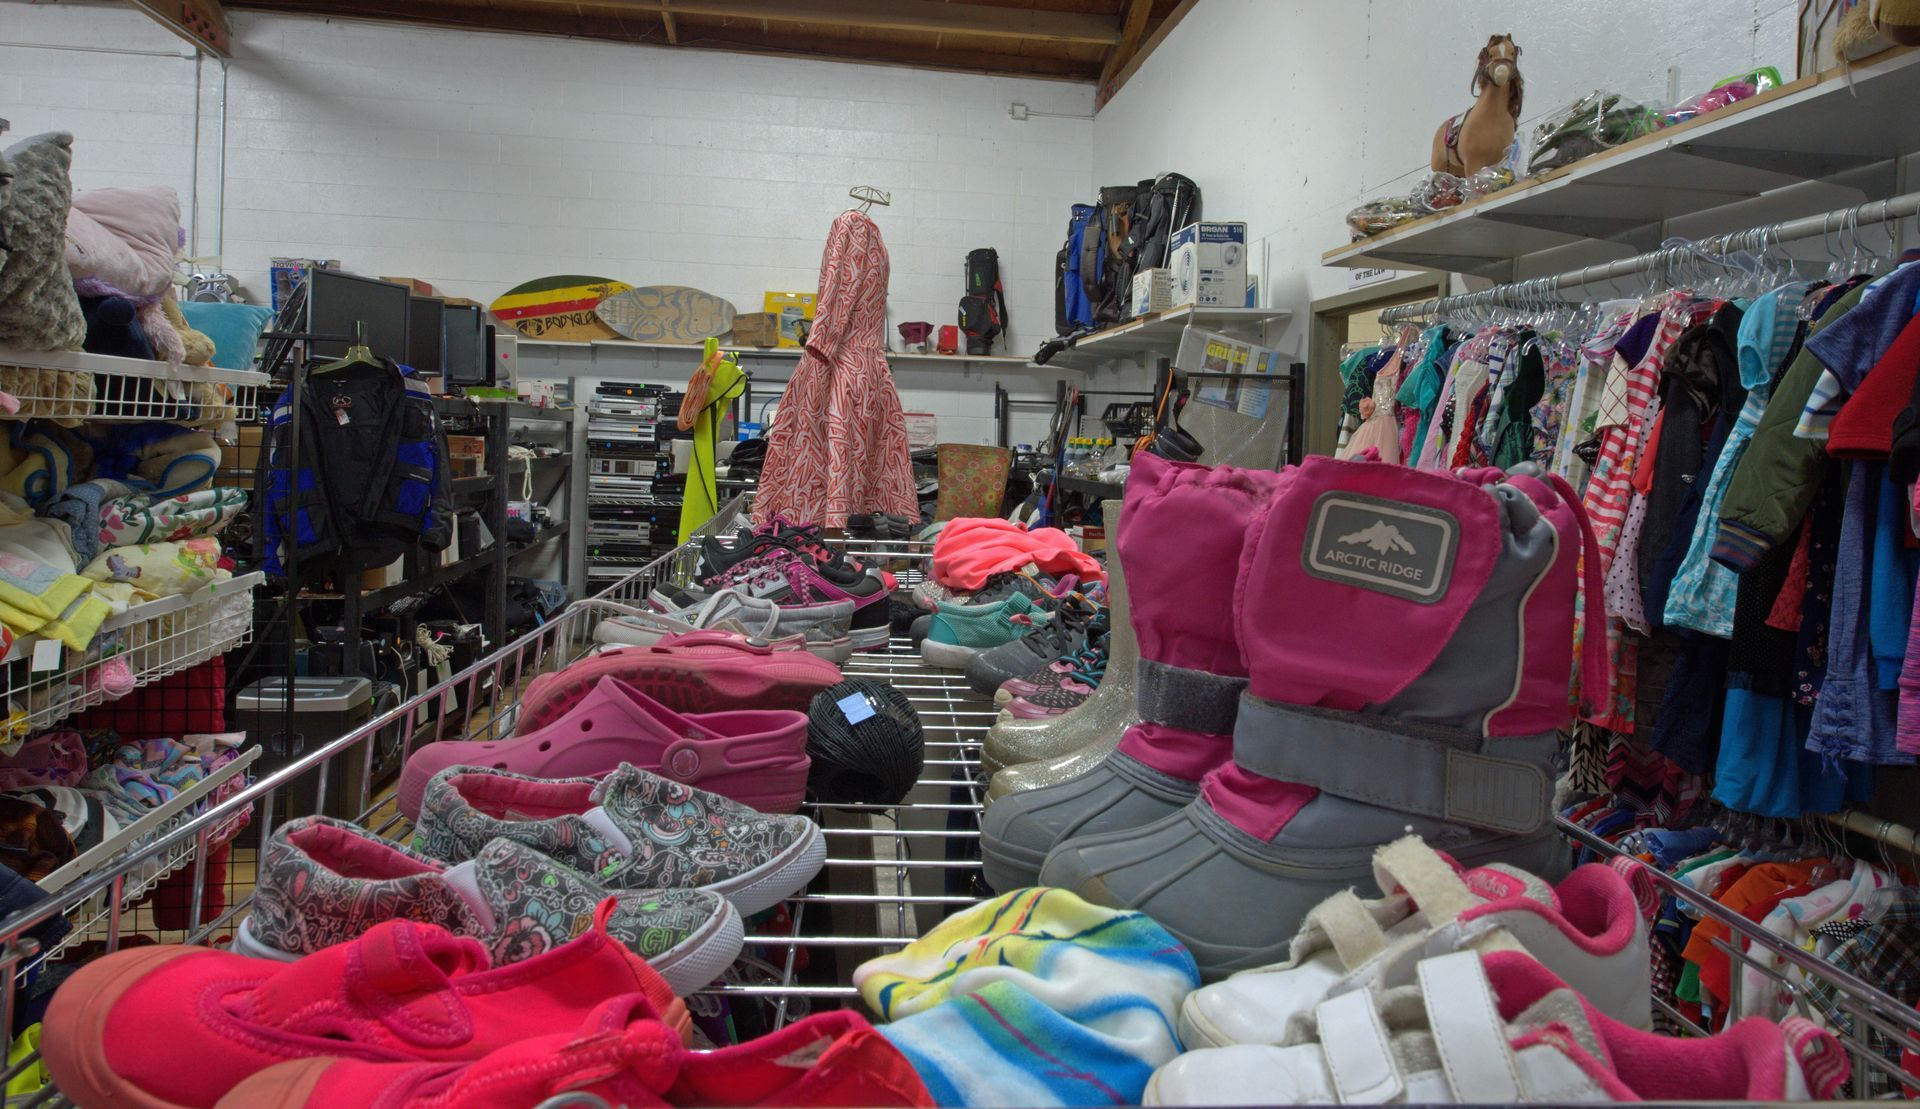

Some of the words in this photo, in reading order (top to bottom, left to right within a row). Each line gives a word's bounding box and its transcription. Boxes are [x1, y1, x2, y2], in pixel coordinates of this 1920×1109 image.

[272, 260, 305, 269] Traveler
[1355, 272, 1362, 281] OF
[1363, 269, 1374, 278] THE
[545, 310, 600, 331] BODYGLOV
[1206, 342, 1249, 366] GRILLE
[1324, 549, 1377, 570] ARCTIC
[1379, 560, 1424, 581] RIDGE
